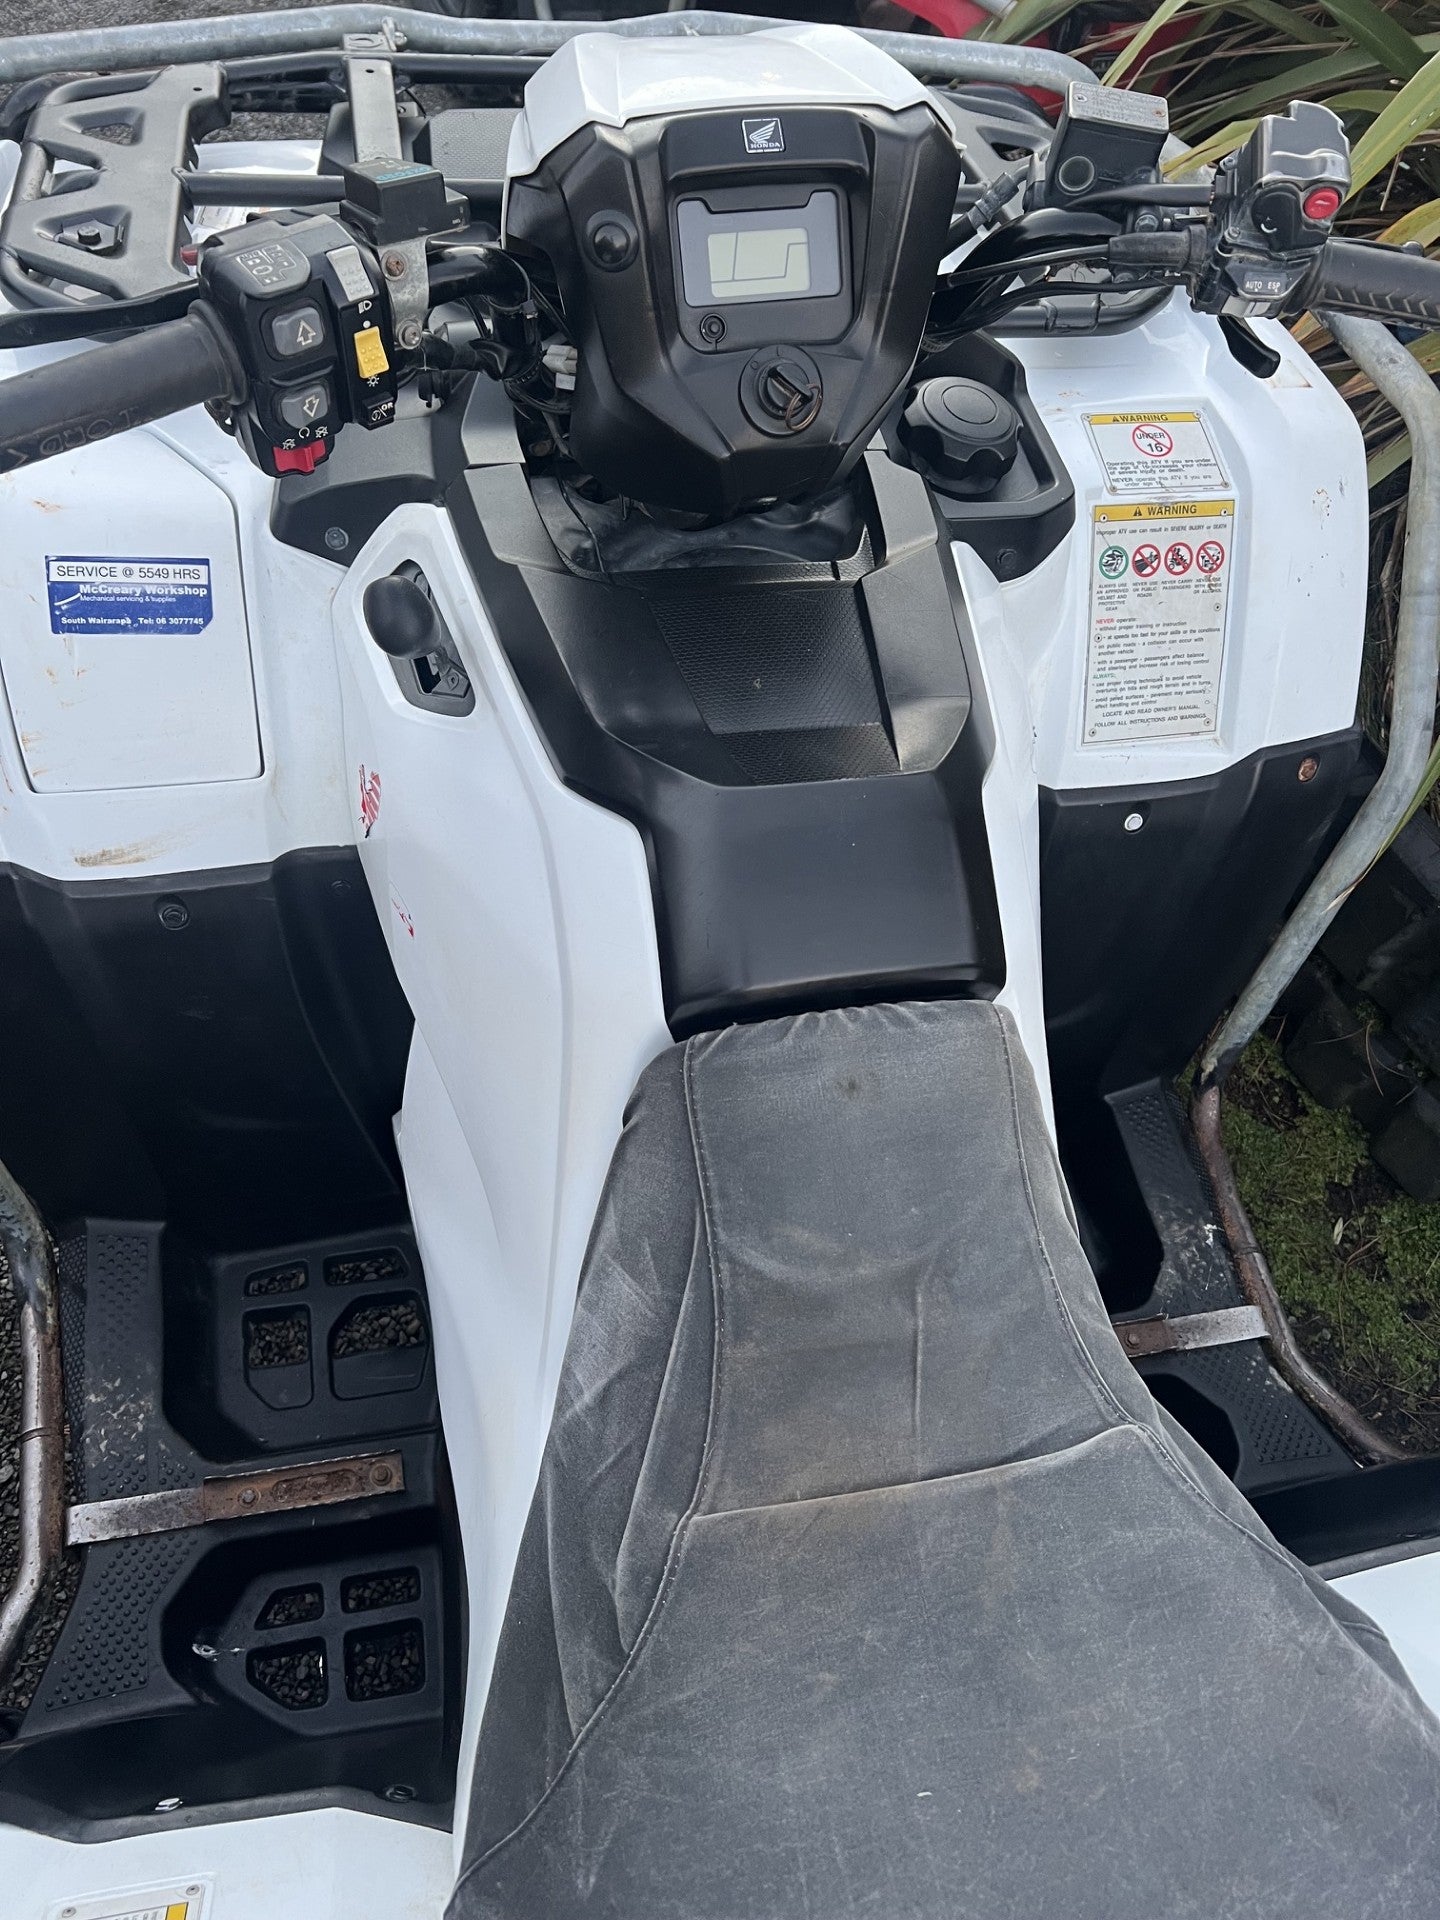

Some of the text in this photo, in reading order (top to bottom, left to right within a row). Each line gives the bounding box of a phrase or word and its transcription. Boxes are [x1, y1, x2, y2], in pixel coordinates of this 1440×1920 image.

[1245, 281, 1280, 290] AUTO ESP
[1122, 414, 1168, 422] WARNING
[1147, 442, 1163, 453] 16
[1147, 504, 1197, 516] WARNING
[56, 565, 200, 580] SERVICE @ 5549 HRS
[80, 584, 208, 598] McCreary Workshop
[61, 617, 86, 625] South
[88, 617, 132, 626] Wairarapa
[138, 617, 154, 625] Tel:
[1130, 716, 1166, 724] INSTRUCTIONS
